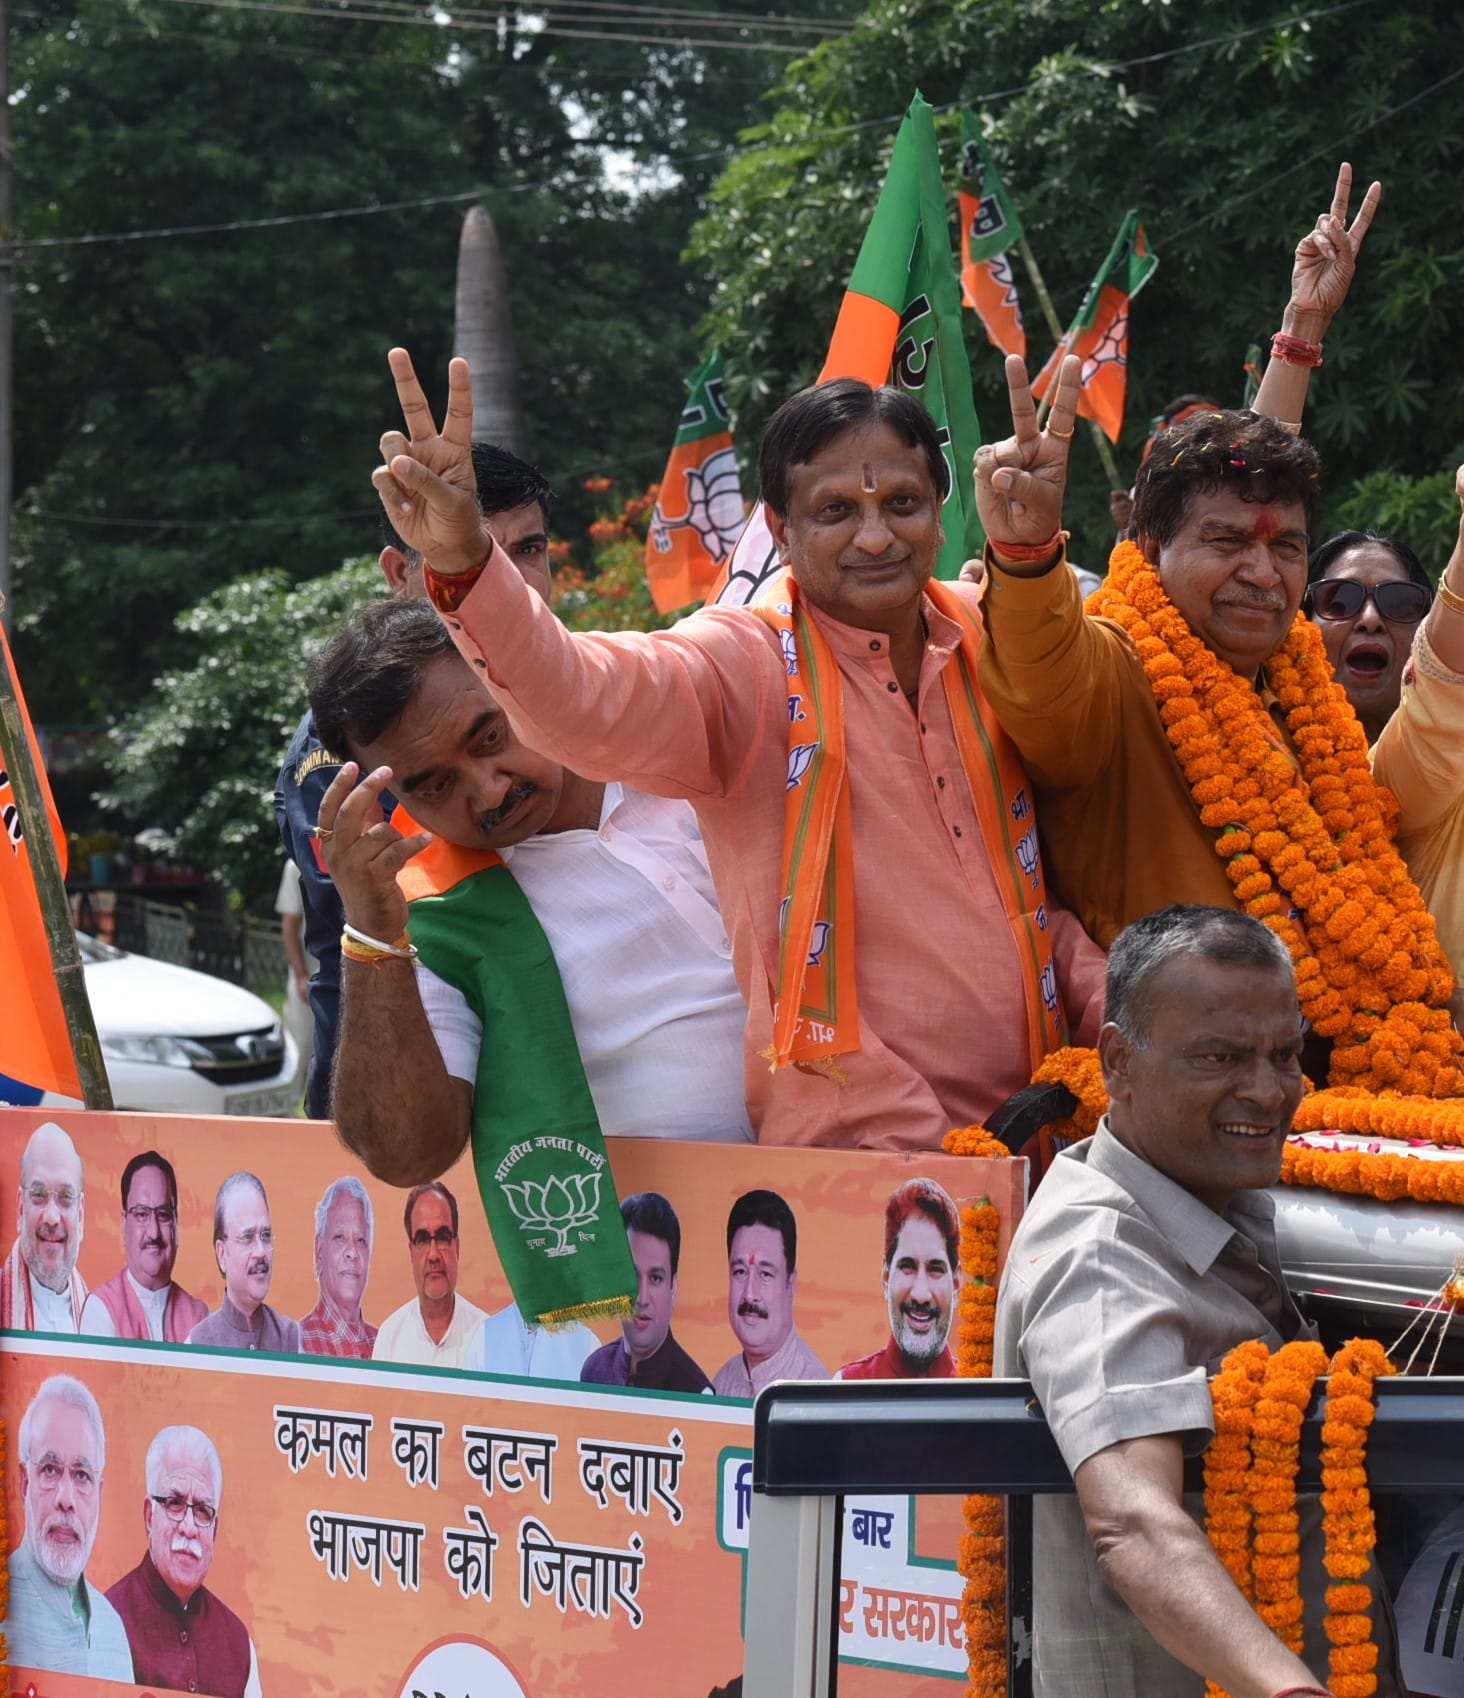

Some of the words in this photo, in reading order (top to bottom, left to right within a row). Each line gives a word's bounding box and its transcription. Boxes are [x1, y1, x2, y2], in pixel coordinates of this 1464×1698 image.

[494, 1140, 533, 1182] भारतीय
[534, 1136, 574, 1152] जनता
[275, 1408, 373, 1480] कमल
[393, 1420, 443, 1489] का
[465, 1430, 557, 1500] बटन
[580, 1433, 684, 1523] दबाएं
[851, 1508, 895, 1549] बार
[309, 1514, 424, 1590] भाजपा
[446, 1510, 498, 1598] को
[520, 1519, 644, 1626] जिताएं
[862, 1586, 966, 1651] सरकार
